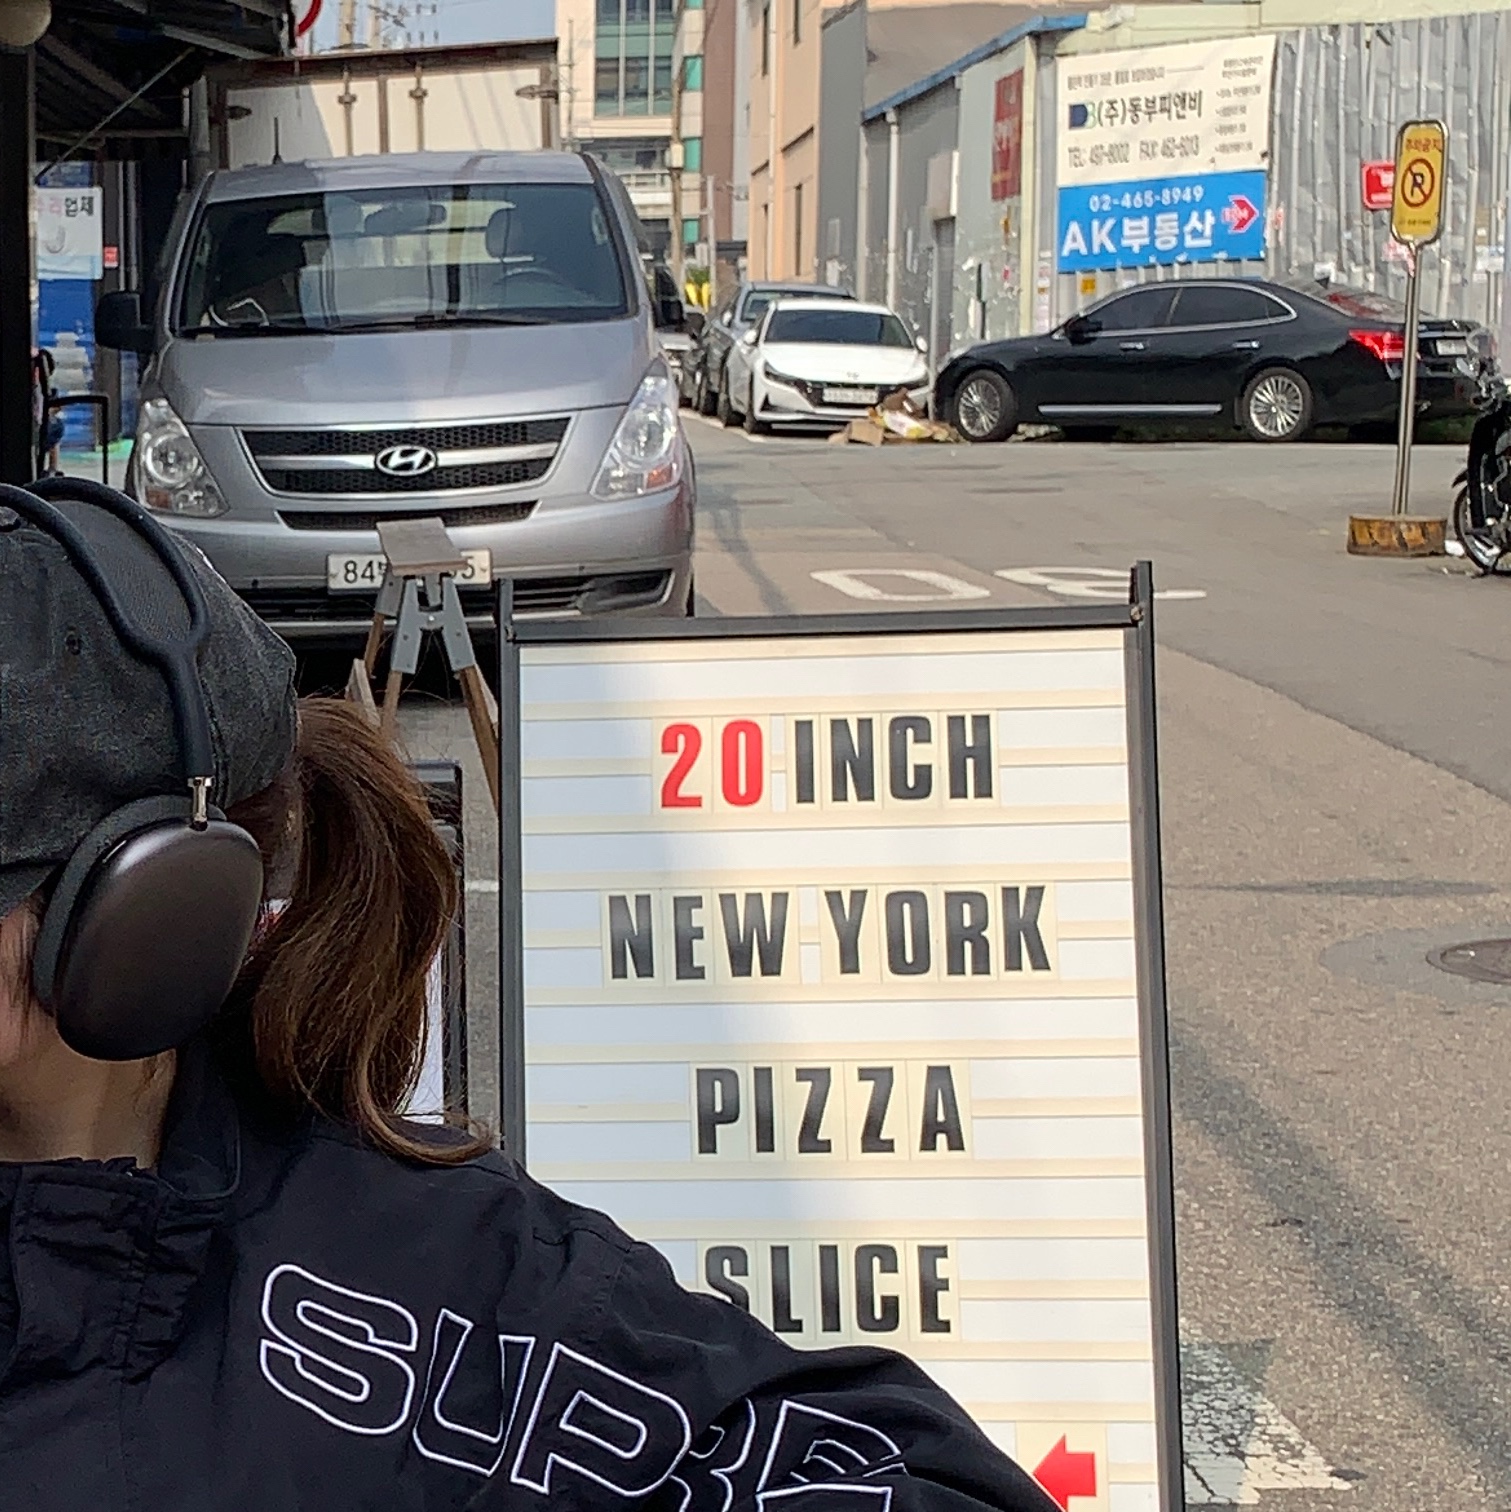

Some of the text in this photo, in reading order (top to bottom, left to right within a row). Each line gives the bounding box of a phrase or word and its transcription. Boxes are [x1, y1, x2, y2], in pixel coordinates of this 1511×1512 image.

[1097, 89, 1204, 128] (주)동부피앤비
[1061, 208, 1216, 257] AK부동산
[1089, 184, 1204, 213] 02-465-8949
[659, 713, 994, 810] 20 INCH
[607, 885, 1052, 981] NEW YORK
[695, 1064, 968, 1155] PIZZA
[704, 1243, 953, 1334] SLICE
